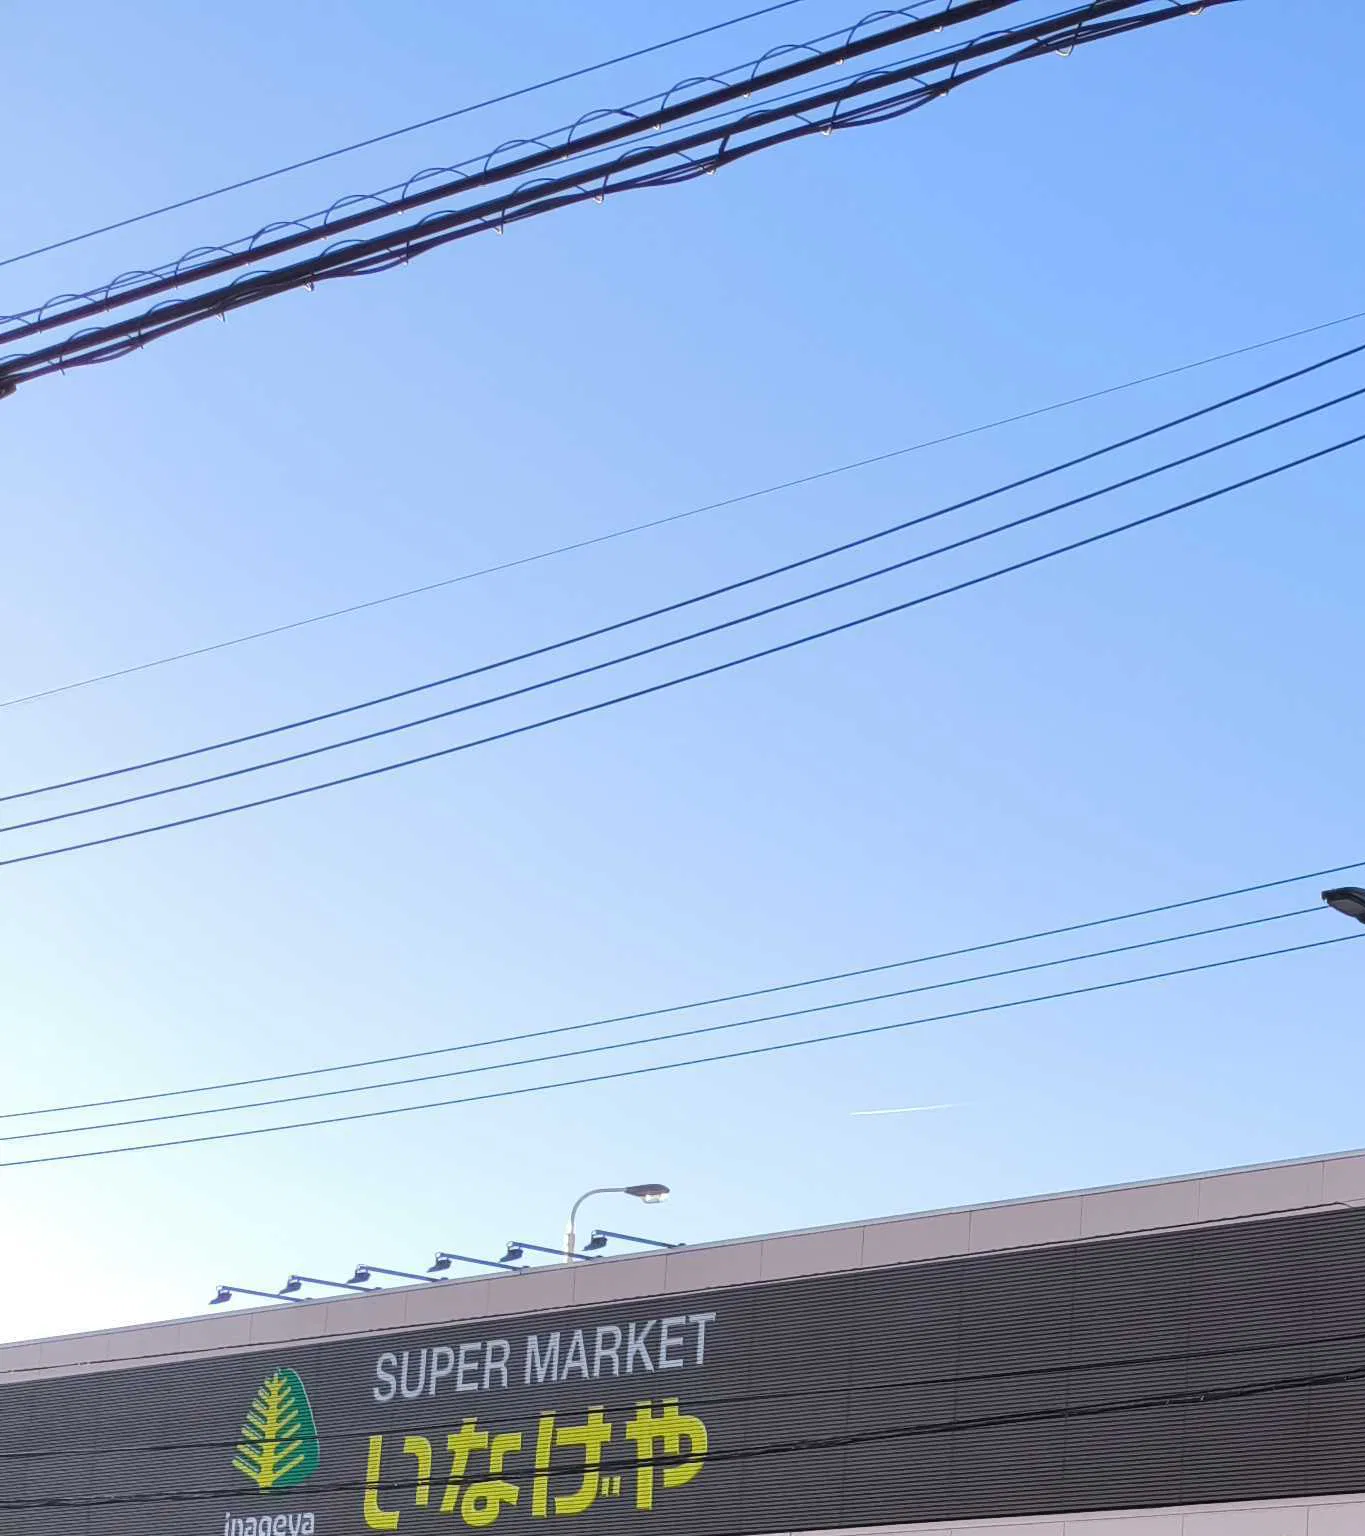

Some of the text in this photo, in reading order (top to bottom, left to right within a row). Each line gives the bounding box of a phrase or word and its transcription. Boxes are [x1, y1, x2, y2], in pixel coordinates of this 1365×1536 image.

[373, 1311, 717, 1402] SUPER MARKET
[363, 1397, 709, 1531] いなげや
